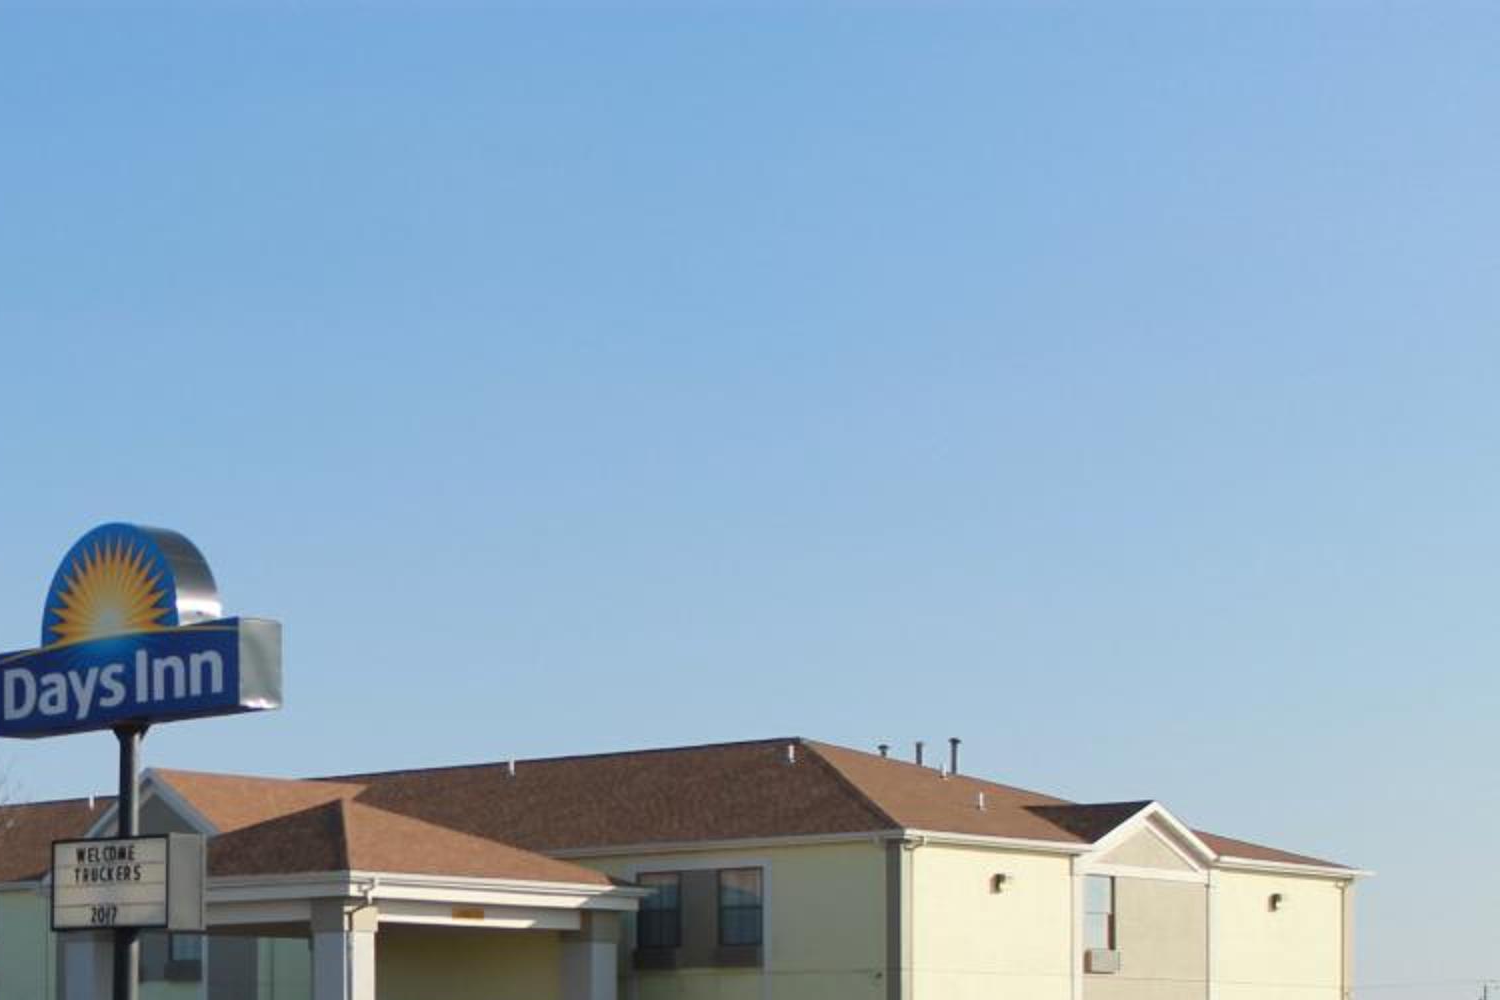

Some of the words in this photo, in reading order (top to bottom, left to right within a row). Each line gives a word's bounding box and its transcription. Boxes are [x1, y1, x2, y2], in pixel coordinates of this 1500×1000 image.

[3, 662, 125, 721] Days
[135, 649, 224, 704] Inn
[76, 846, 135, 863] WELCOME
[75, 865, 141, 883] TRUCKERS
